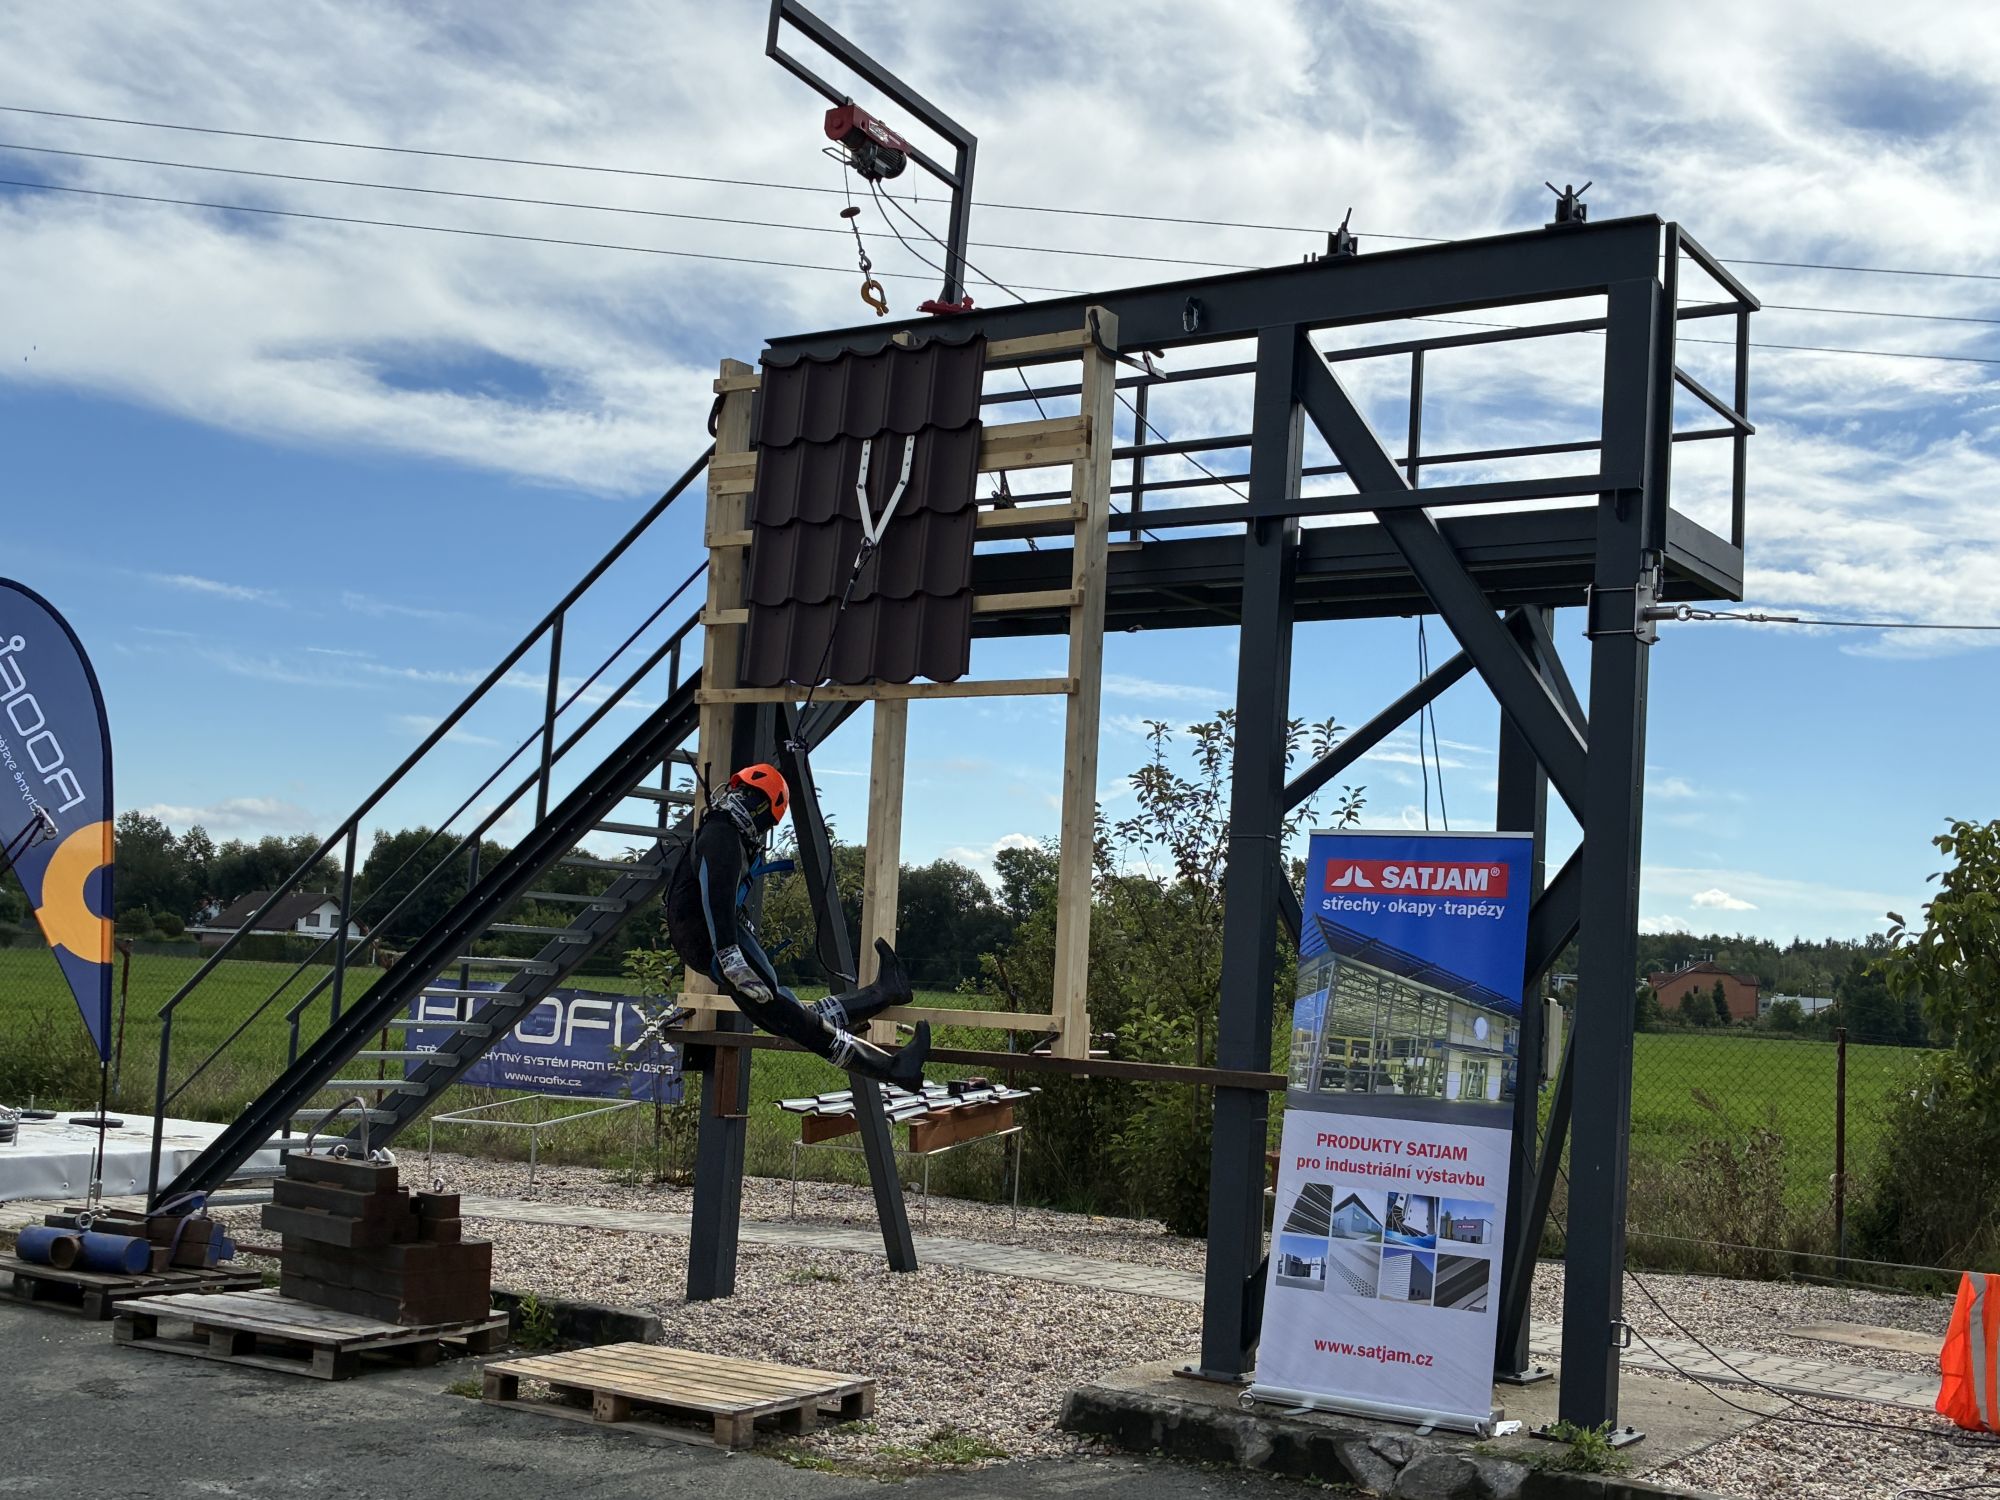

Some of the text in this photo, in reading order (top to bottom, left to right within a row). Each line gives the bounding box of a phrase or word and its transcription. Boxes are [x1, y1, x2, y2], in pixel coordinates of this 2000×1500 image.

[1322, 895, 1505, 919] střechy okapy trapézy
[523, 1055, 568, 1068] SYSTÉM
[571, 1060, 605, 1071] PROTI
[504, 1071, 582, 1087] www.roofix.cz
[1316, 1132, 1468, 1161] PRODUKTY SATJAM
[1296, 1156, 1485, 1186] pro industriální výstavbu
[1314, 1339, 1434, 1367] www.satjam.cz
